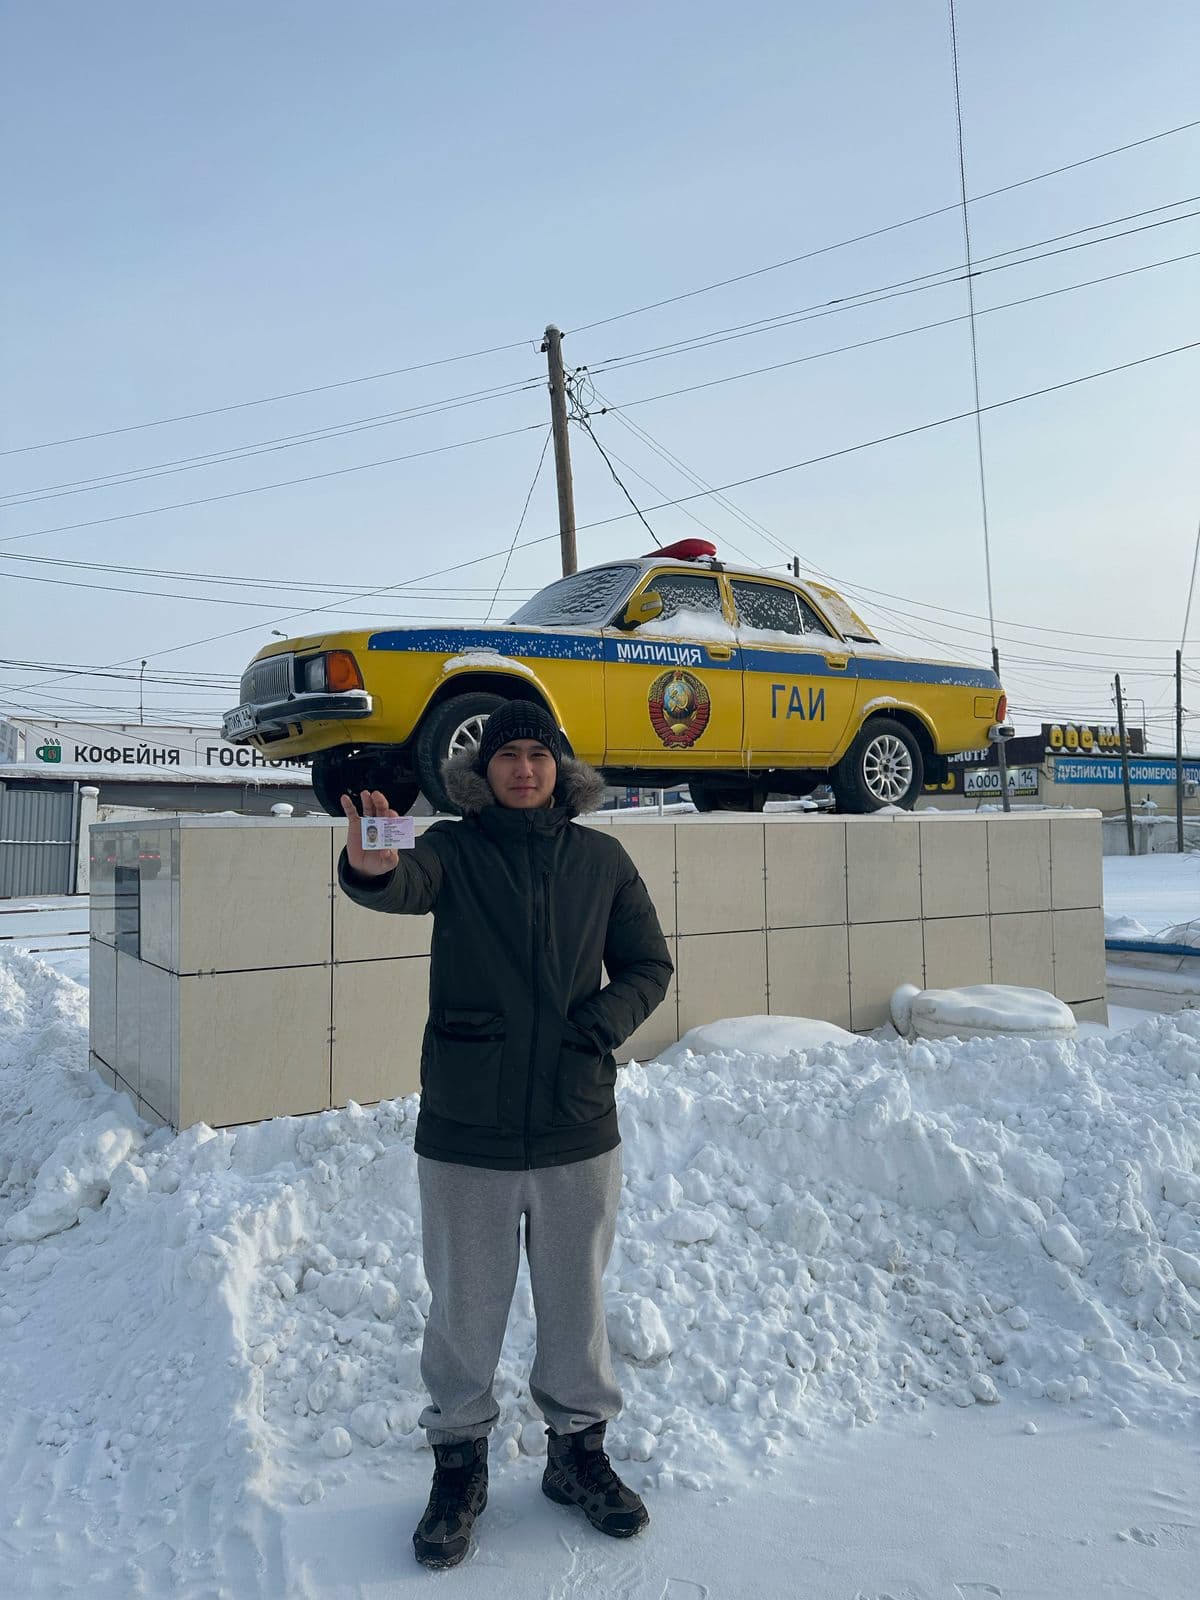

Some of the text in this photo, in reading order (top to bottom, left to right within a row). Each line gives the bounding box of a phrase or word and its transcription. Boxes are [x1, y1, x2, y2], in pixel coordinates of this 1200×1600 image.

[616, 643, 702, 664] МИЛИЦИЯ
[771, 684, 825, 722] ГАИ
[74, 744, 180, 766] КОФЕЙНЯ
[1021, 770, 1033, 784] 14
[1057, 765, 1117, 780] ДУБЛИКАТЫ
[1118, 766, 1178, 780] ГСНОМЕРОВ
